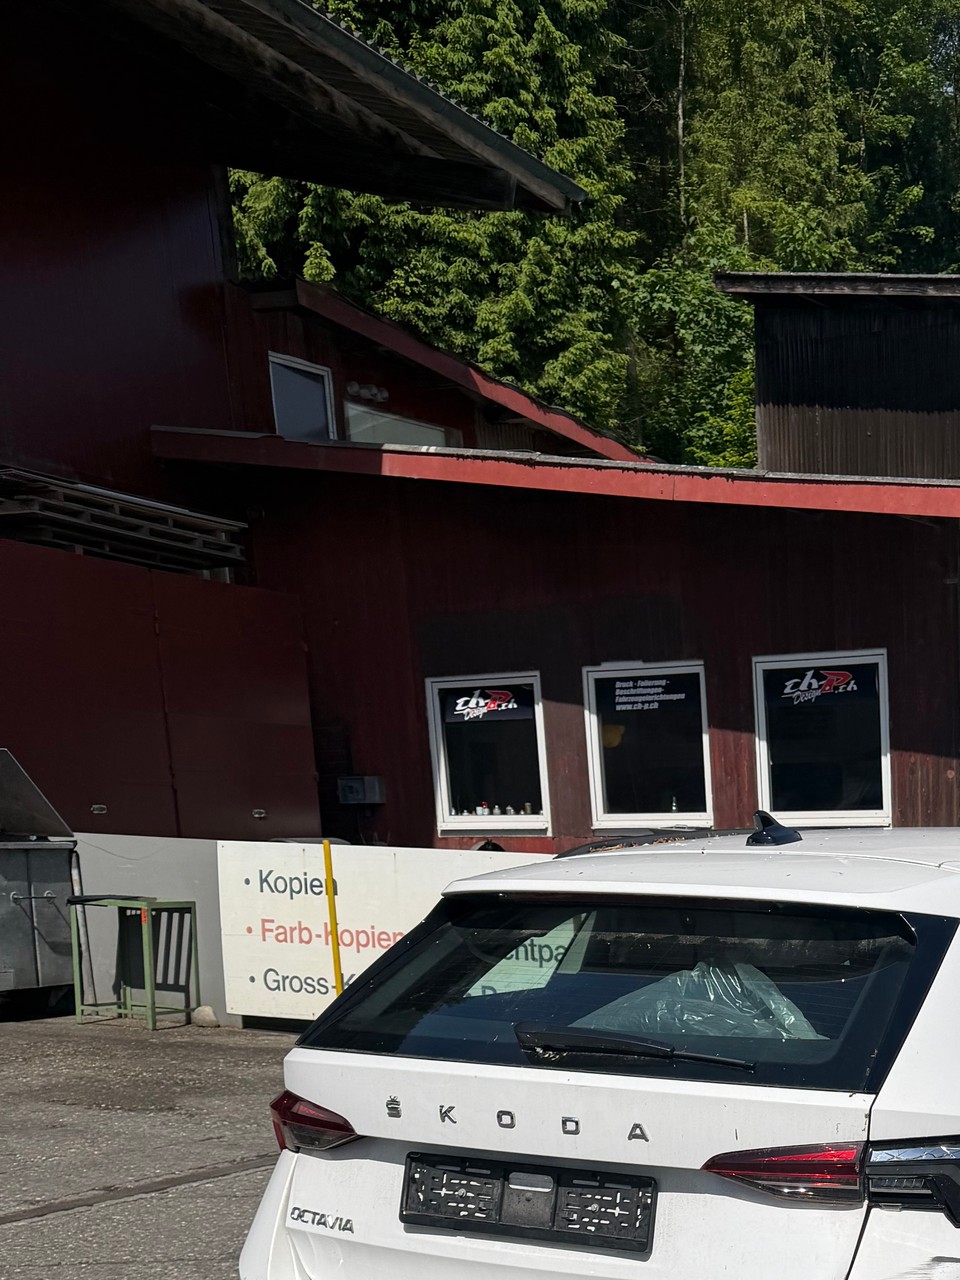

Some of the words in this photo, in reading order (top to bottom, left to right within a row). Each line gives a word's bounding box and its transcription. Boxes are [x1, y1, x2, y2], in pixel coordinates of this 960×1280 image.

[258, 869, 339, 900] Kopien
[386, 1095, 650, 1143] ŠKODA
[289, 1205, 355, 1235] OCTAVIA
